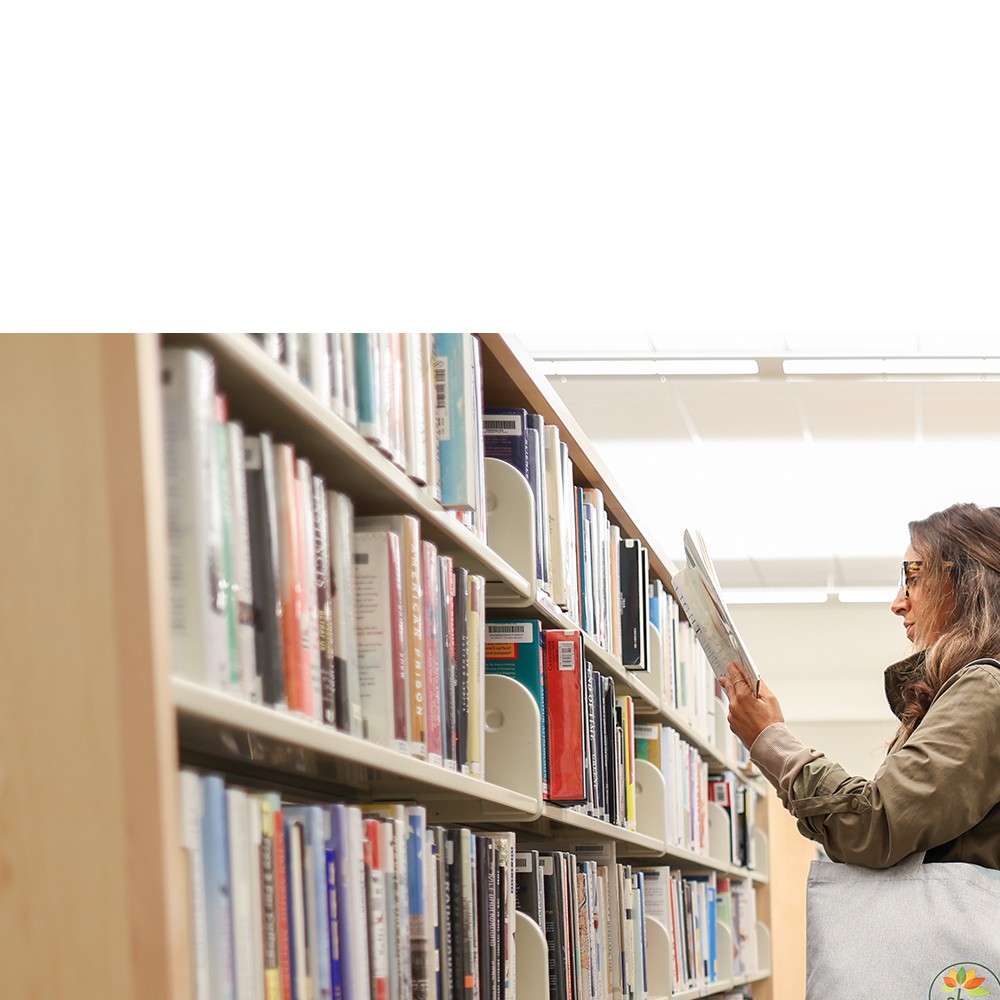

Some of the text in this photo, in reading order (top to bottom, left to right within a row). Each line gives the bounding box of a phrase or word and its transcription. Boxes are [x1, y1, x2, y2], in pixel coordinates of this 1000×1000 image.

[410, 544, 424, 716] AMERICAN PRISON
[588, 694, 594, 706] OF
